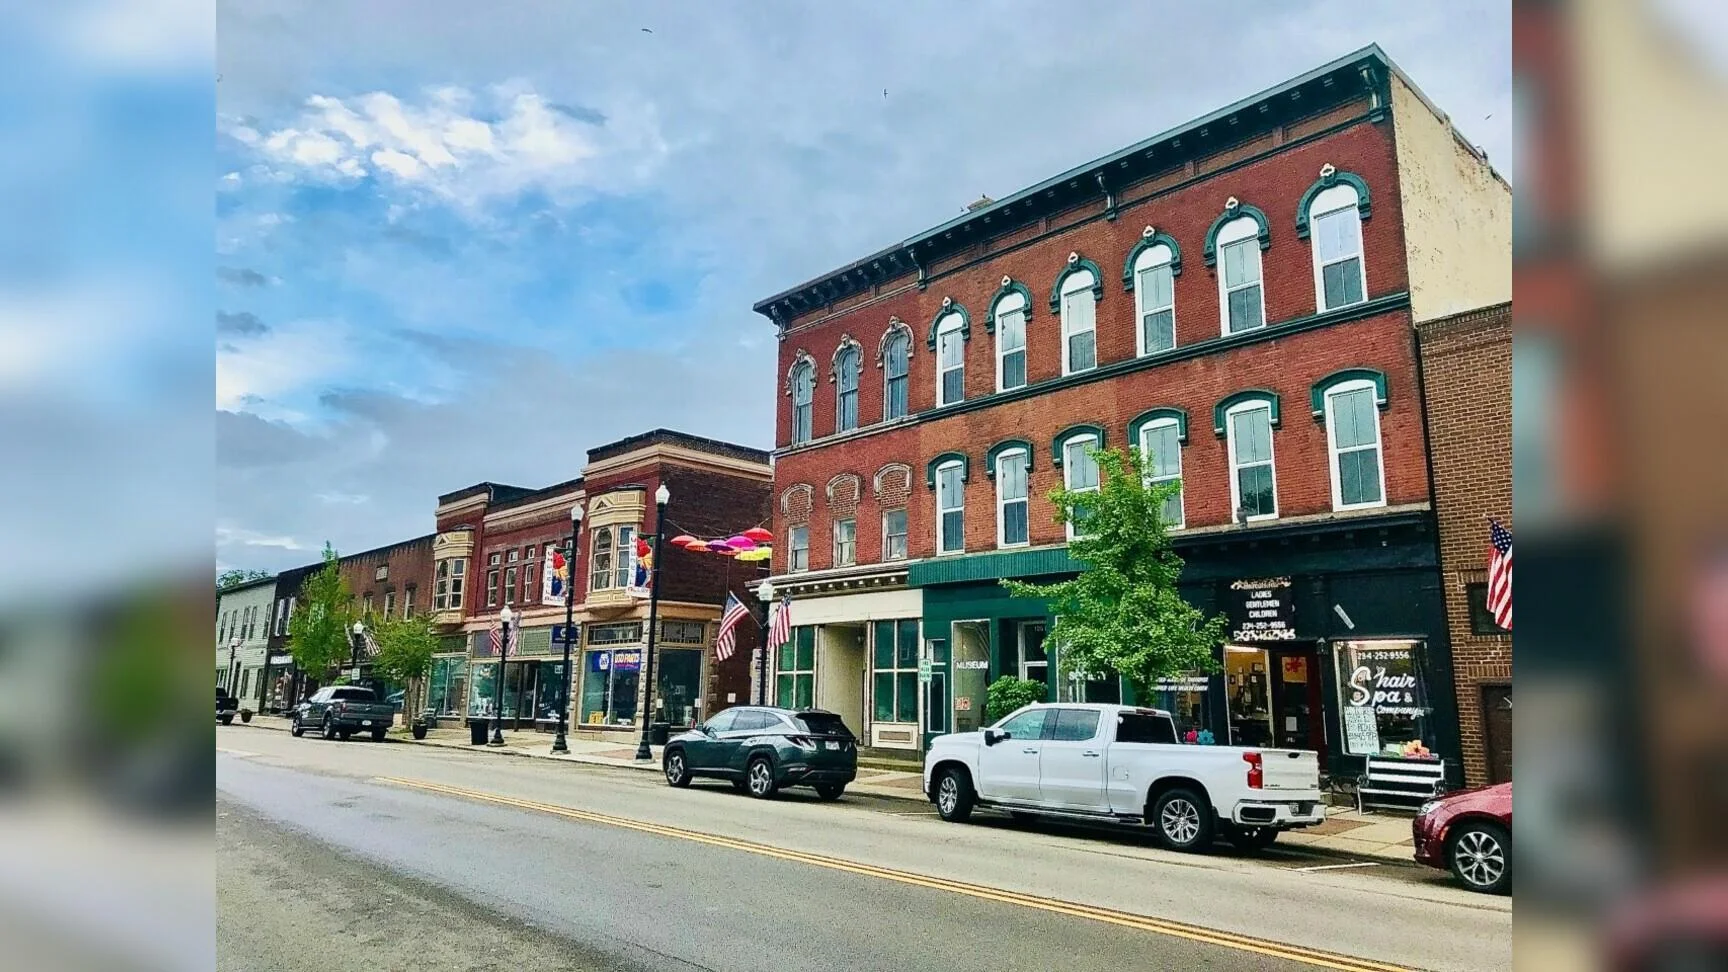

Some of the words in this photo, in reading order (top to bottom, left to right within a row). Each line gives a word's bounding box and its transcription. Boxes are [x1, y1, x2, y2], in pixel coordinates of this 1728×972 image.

[1251, 591, 1272, 599] LADIES
[1245, 600, 1280, 609] GENTLEMEN
[1249, 610, 1277, 618] CHILDREN
[1242, 621, 1286, 630] 234-252-9556
[1357, 651, 1410, 660] 234-252-9556
[956, 661, 988, 669] MUSEUM
